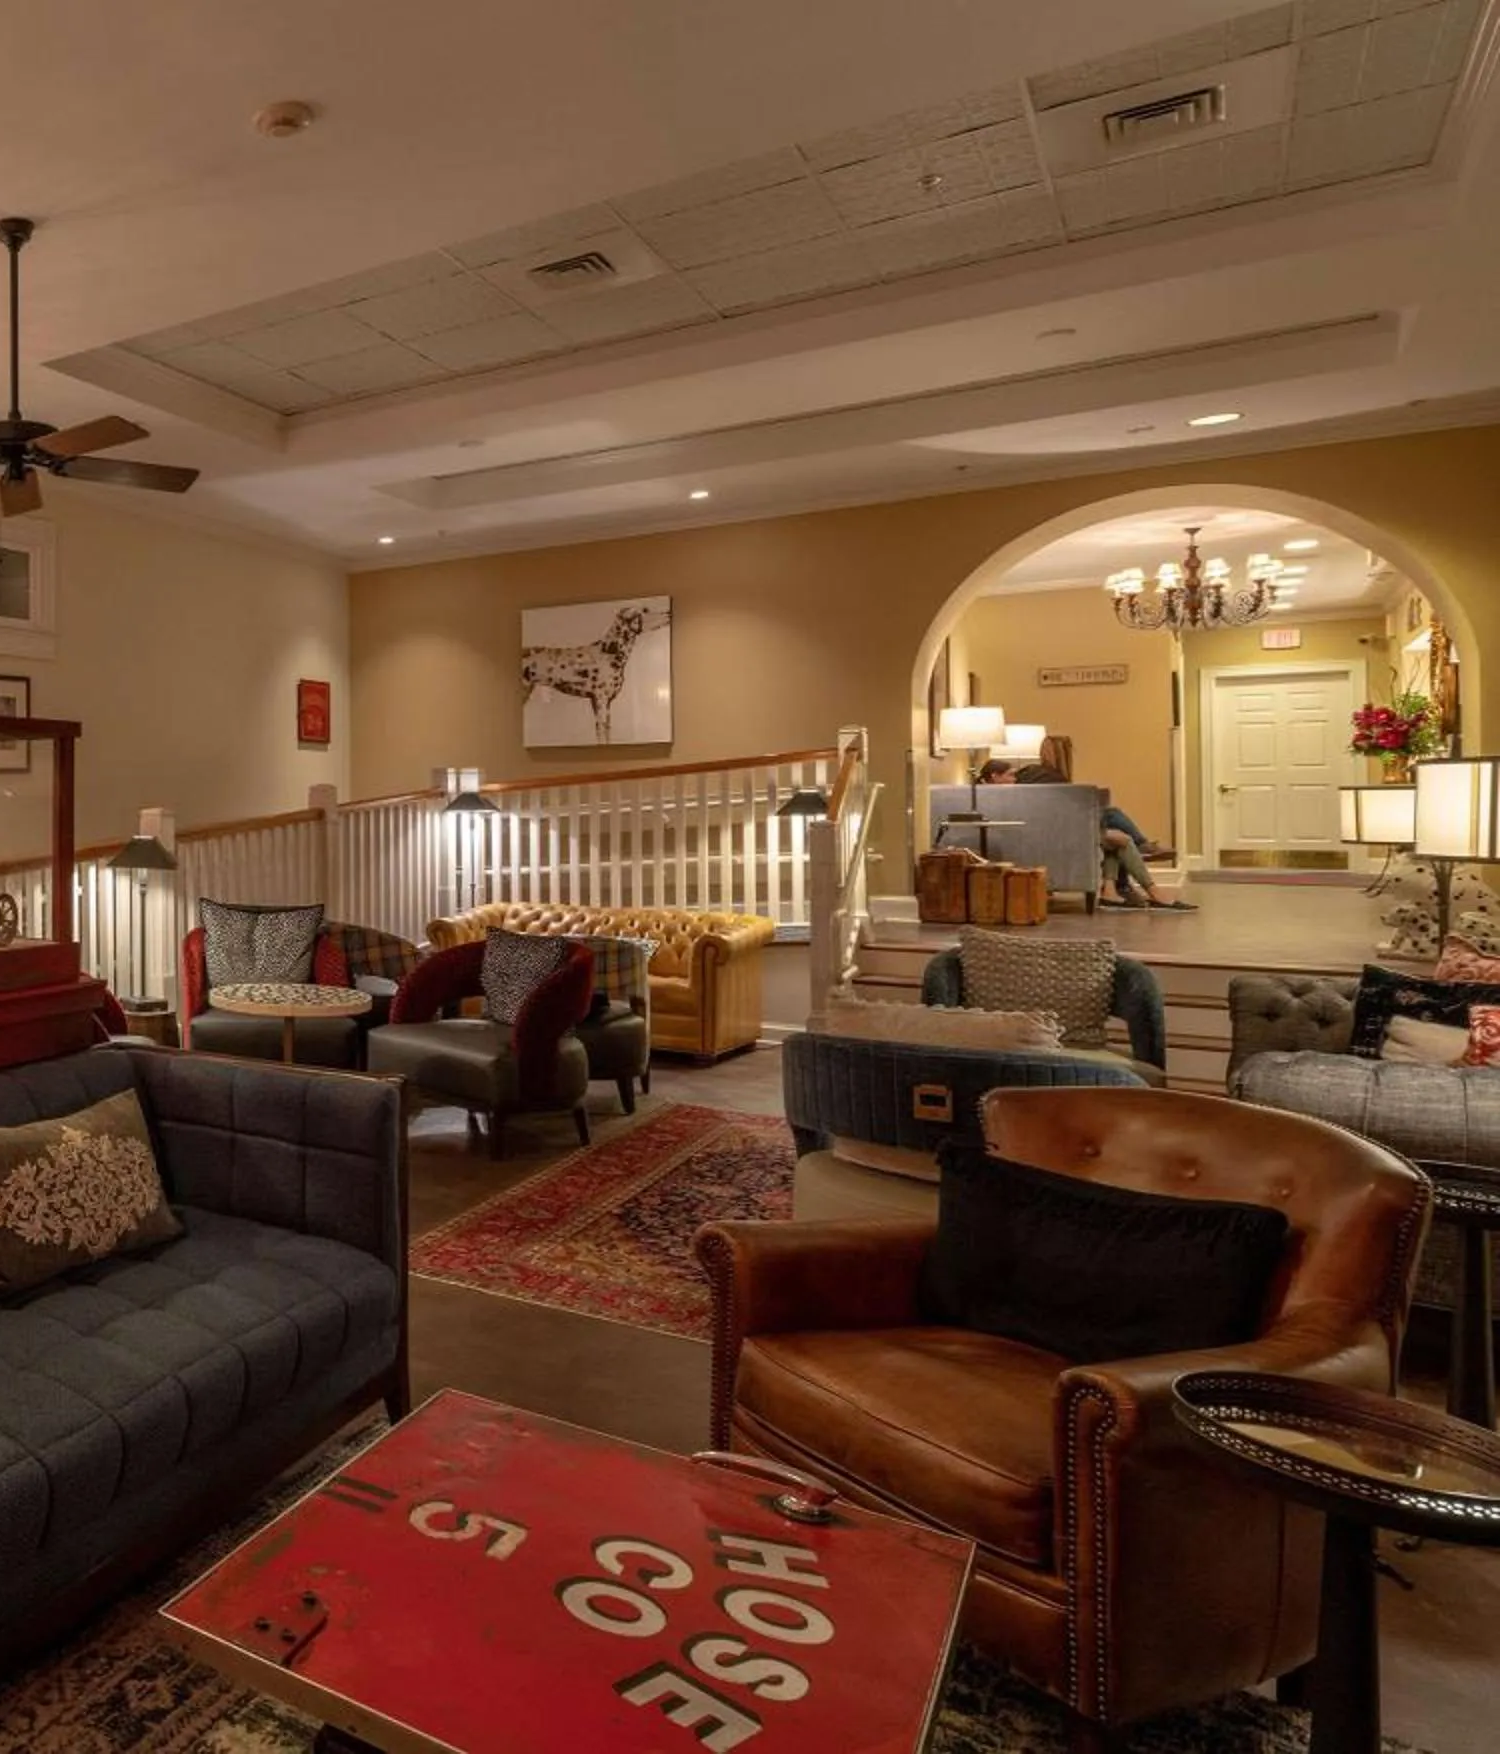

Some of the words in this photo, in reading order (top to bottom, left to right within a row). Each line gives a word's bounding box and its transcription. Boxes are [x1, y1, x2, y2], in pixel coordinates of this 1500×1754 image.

[407, 1500, 528, 1560] 5
[556, 1535, 695, 1638] CO
[614, 1530, 835, 1754] HOSE
